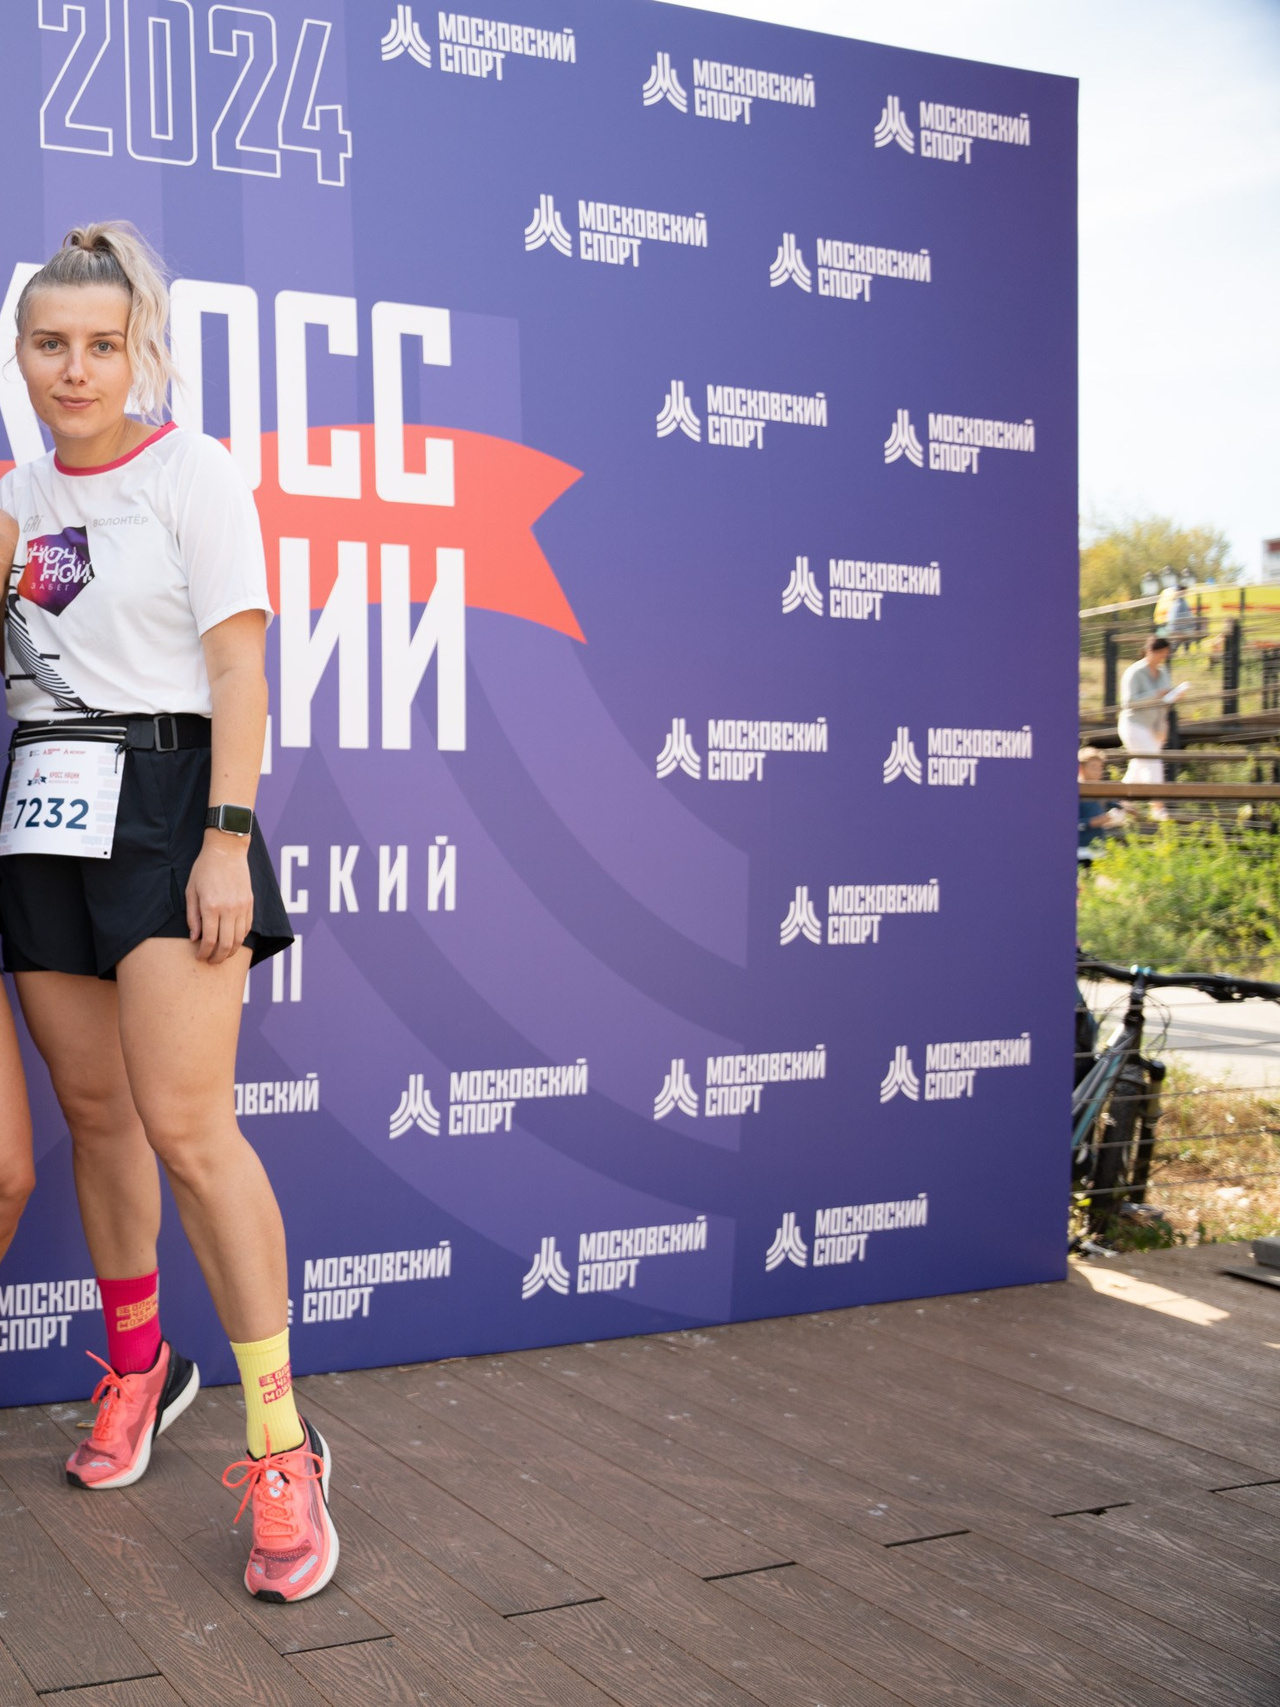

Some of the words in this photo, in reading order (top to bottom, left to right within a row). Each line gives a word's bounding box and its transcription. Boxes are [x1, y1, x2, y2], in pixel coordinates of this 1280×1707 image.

[439, 12, 575, 63] МОСКОВСКИЙ
[440, 42, 505, 80] СПОРТ
[38, 0, 352, 187] 2024
[693, 59, 815, 107] МОСКОВСКИЙ
[695, 88, 752, 124] СПОРТ
[920, 101, 1029, 145] МОСКОВСКИЙ
[921, 130, 973, 164] СПОРТ
[579, 200, 707, 247] МОСКОВСКИЙ
[580, 231, 641, 267] СПОРТ
[817, 238, 930, 282] МОСКОВСКИЙ
[818, 267, 872, 302] СПОРТ
[707, 384, 827, 427] МОСКОВСКИЙ
[708, 415, 765, 449] СПОРТ
[929, 413, 1034, 451] МОСКОВСКИЙ
[929, 442, 980, 474] СПОРТ
[93, 514, 148, 527] ВОЛОНТЁР
[31, 582, 70, 592] ЗАБЕГ
[829, 559, 940, 595] МОСКОВСКИЙ
[830, 589, 883, 620] СПОРТ
[708, 717, 827, 752] МОСКОВСКИЙ
[928, 726, 1032, 758] МОСКОВСКИЙ
[708, 751, 766, 781] СПОРТ
[928, 757, 978, 786] СПОРТ
[13, 797, 89, 830] 7232
[829, 879, 939, 914] МОСКОВСКИЙ
[828, 915, 881, 944] СПОРТ
[706, 1044, 826, 1086] МОСКОВСКИЙ
[926, 1033, 1030, 1071] МОСКОВСКИЙ
[450, 1058, 588, 1102] МОСКОВСКИЙ
[925, 1070, 976, 1100] СПОРТ
[449, 1101, 515, 1135] СПОРТ
[705, 1084, 763, 1117] СПОРТ
[815, 1193, 927, 1237] МОСКОВСКИЙ
[579, 1215, 707, 1262] МОСКОВСКИЙ
[813, 1233, 868, 1266] СПОРТ
[304, 1241, 451, 1290] МОСКОВСКИЙ
[577, 1259, 639, 1293] СПОРТ
[303, 1287, 373, 1323] СПОРТ
